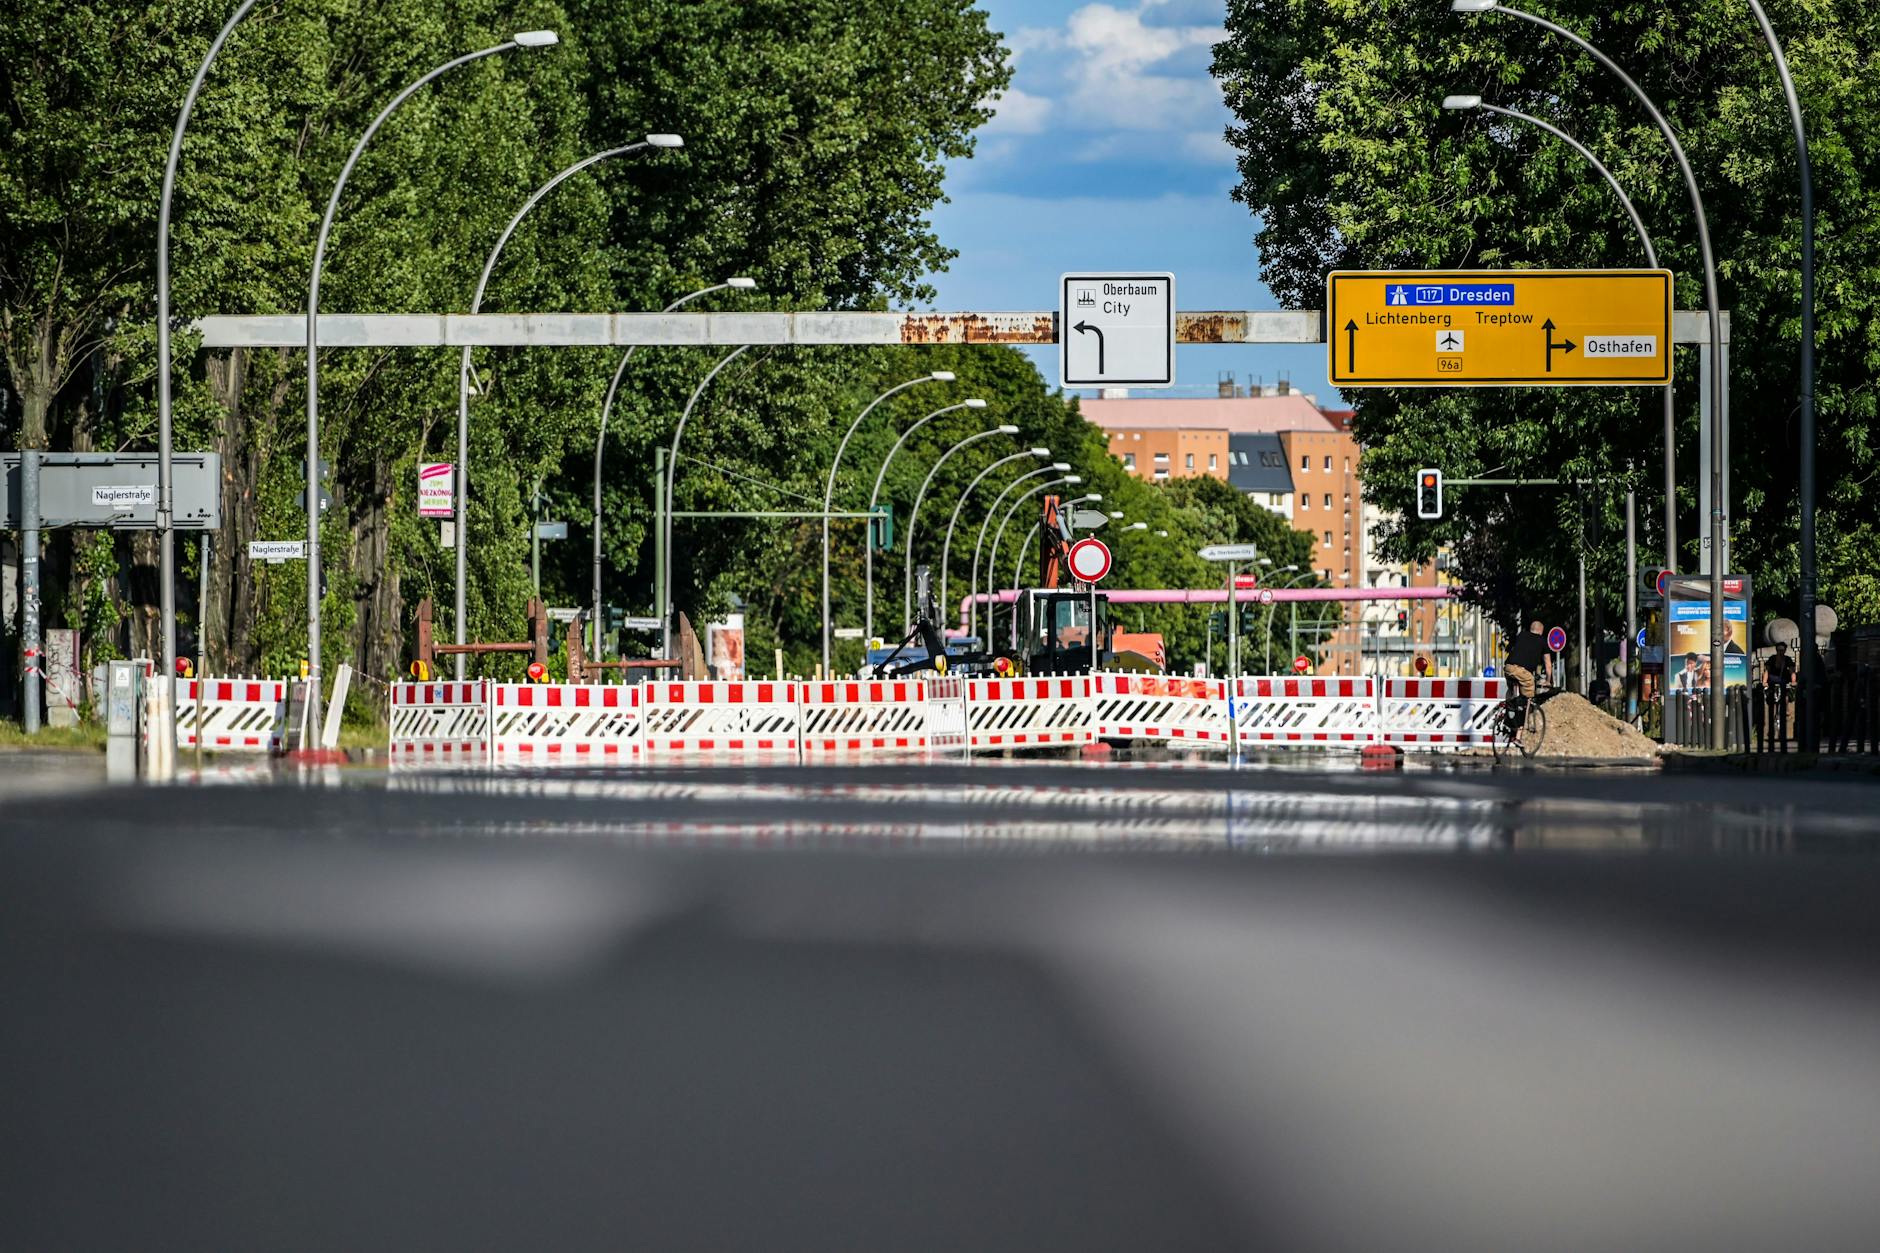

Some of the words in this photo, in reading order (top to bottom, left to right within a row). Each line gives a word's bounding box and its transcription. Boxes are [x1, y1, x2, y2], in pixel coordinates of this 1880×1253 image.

[1103, 283, 1157, 295] Oberbaum
[1421, 289, 1437, 301] 117
[1450, 288, 1510, 301] Dresden
[1103, 301, 1130, 316] City
[1366, 312, 1451, 327] Lichtenberg
[1475, 312, 1533, 326] Treptow
[1588, 340, 1652, 353] Osthafen
[1440, 360, 1459, 370] 96a
[96, 489, 151, 501] Naglerstraße
[252, 545, 300, 554] Naglerstraße
